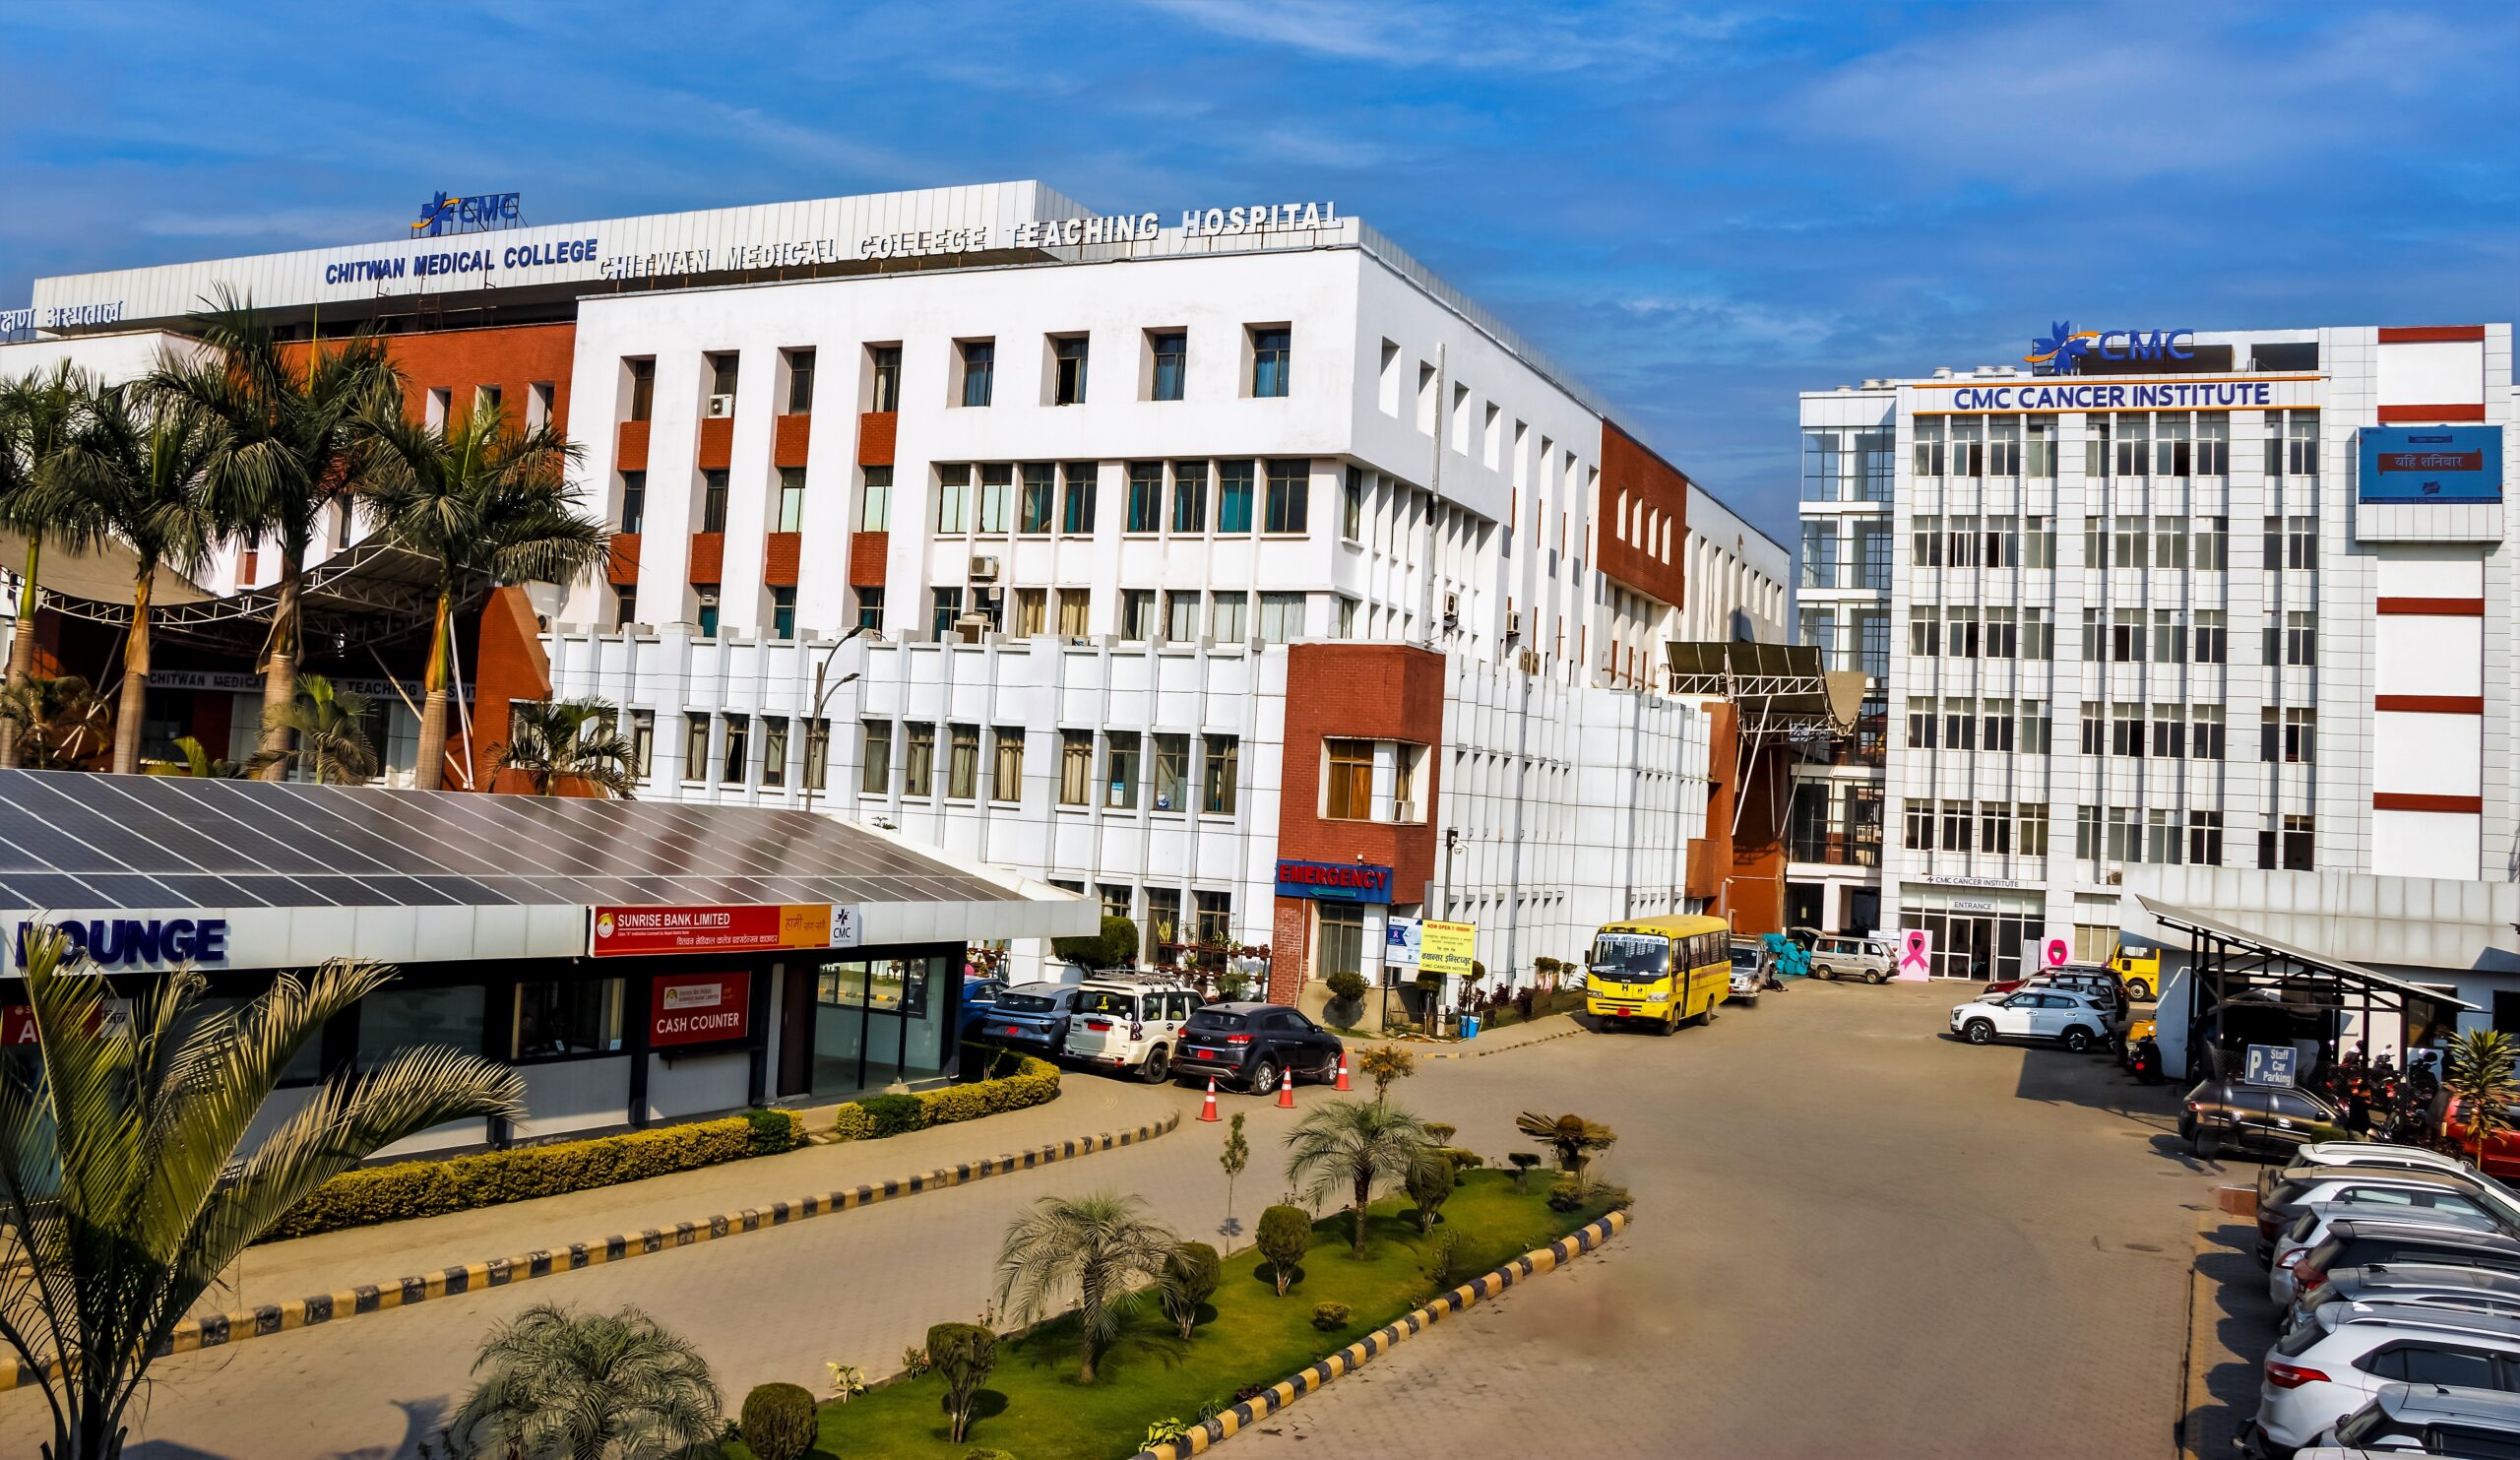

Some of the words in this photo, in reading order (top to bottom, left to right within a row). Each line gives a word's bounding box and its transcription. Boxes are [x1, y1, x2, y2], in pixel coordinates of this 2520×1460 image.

[459, 194, 519, 223] CMC
[598, 249, 711, 282] CHITWAN
[724, 239, 837, 272] MEDICAL
[859, 227, 986, 261] COLLEGE
[1007, 212, 1160, 248] TEACHING
[1182, 201, 1344, 238] HOSPITAL
[325, 257, 406, 285] CHITWAN
[413, 250, 494, 277] MEDICAL
[504, 239, 598, 268] COLLEGE
[46, 300, 123, 328] अस्पताल
[2098, 329, 2195, 361] CMC
[1953, 388, 2011, 410] CMC
[2018, 386, 2124, 408] CANCER
[2132, 383, 2270, 407] INSTITUTE
[150, 672, 205, 686] CHITWAN
[1279, 864, 1386, 888] EMERGENCY
[617, 914, 662, 927] SUNRISE
[663, 914, 691, 926] BANK
[693, 913, 730, 925] LIMITED
[833, 927, 851, 938] CMC
[657, 1017, 687, 1034] CASH
[690, 1012, 739, 1031] COUNTER
[2249, 1050, 2262, 1078] P
[2271, 1048, 2289, 1059] Staff
[2272, 1060, 2286, 1071] Car
[2263, 1070, 2292, 1086] Parking
